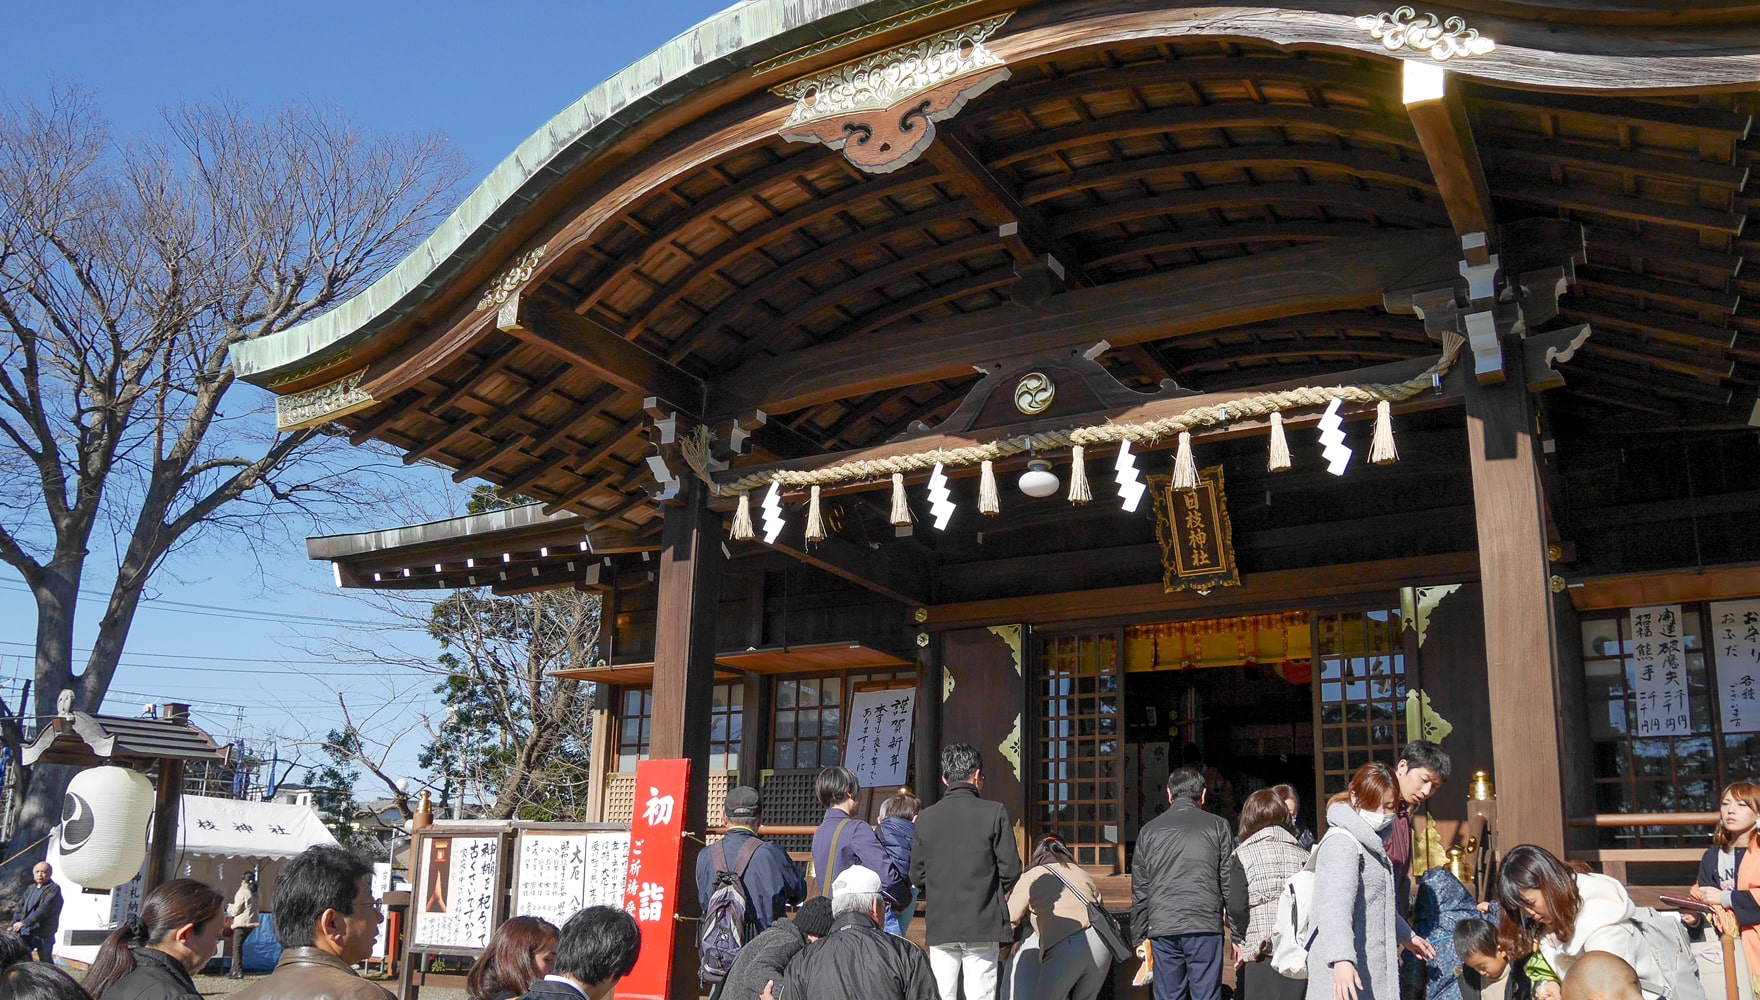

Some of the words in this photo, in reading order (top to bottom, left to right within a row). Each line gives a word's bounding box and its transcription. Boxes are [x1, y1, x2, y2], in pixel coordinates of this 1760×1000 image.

[1184, 491, 1211, 566] 日枝神社
[1635, 613, 1655, 681] 招福熊手
[1721, 612, 1739, 657] おふだ
[1739, 675, 1755, 700] 各種
[857, 707, 872, 772] ありますように
[888, 696, 910, 776] 謹賀新年
[638, 786, 675, 921] 初詣
